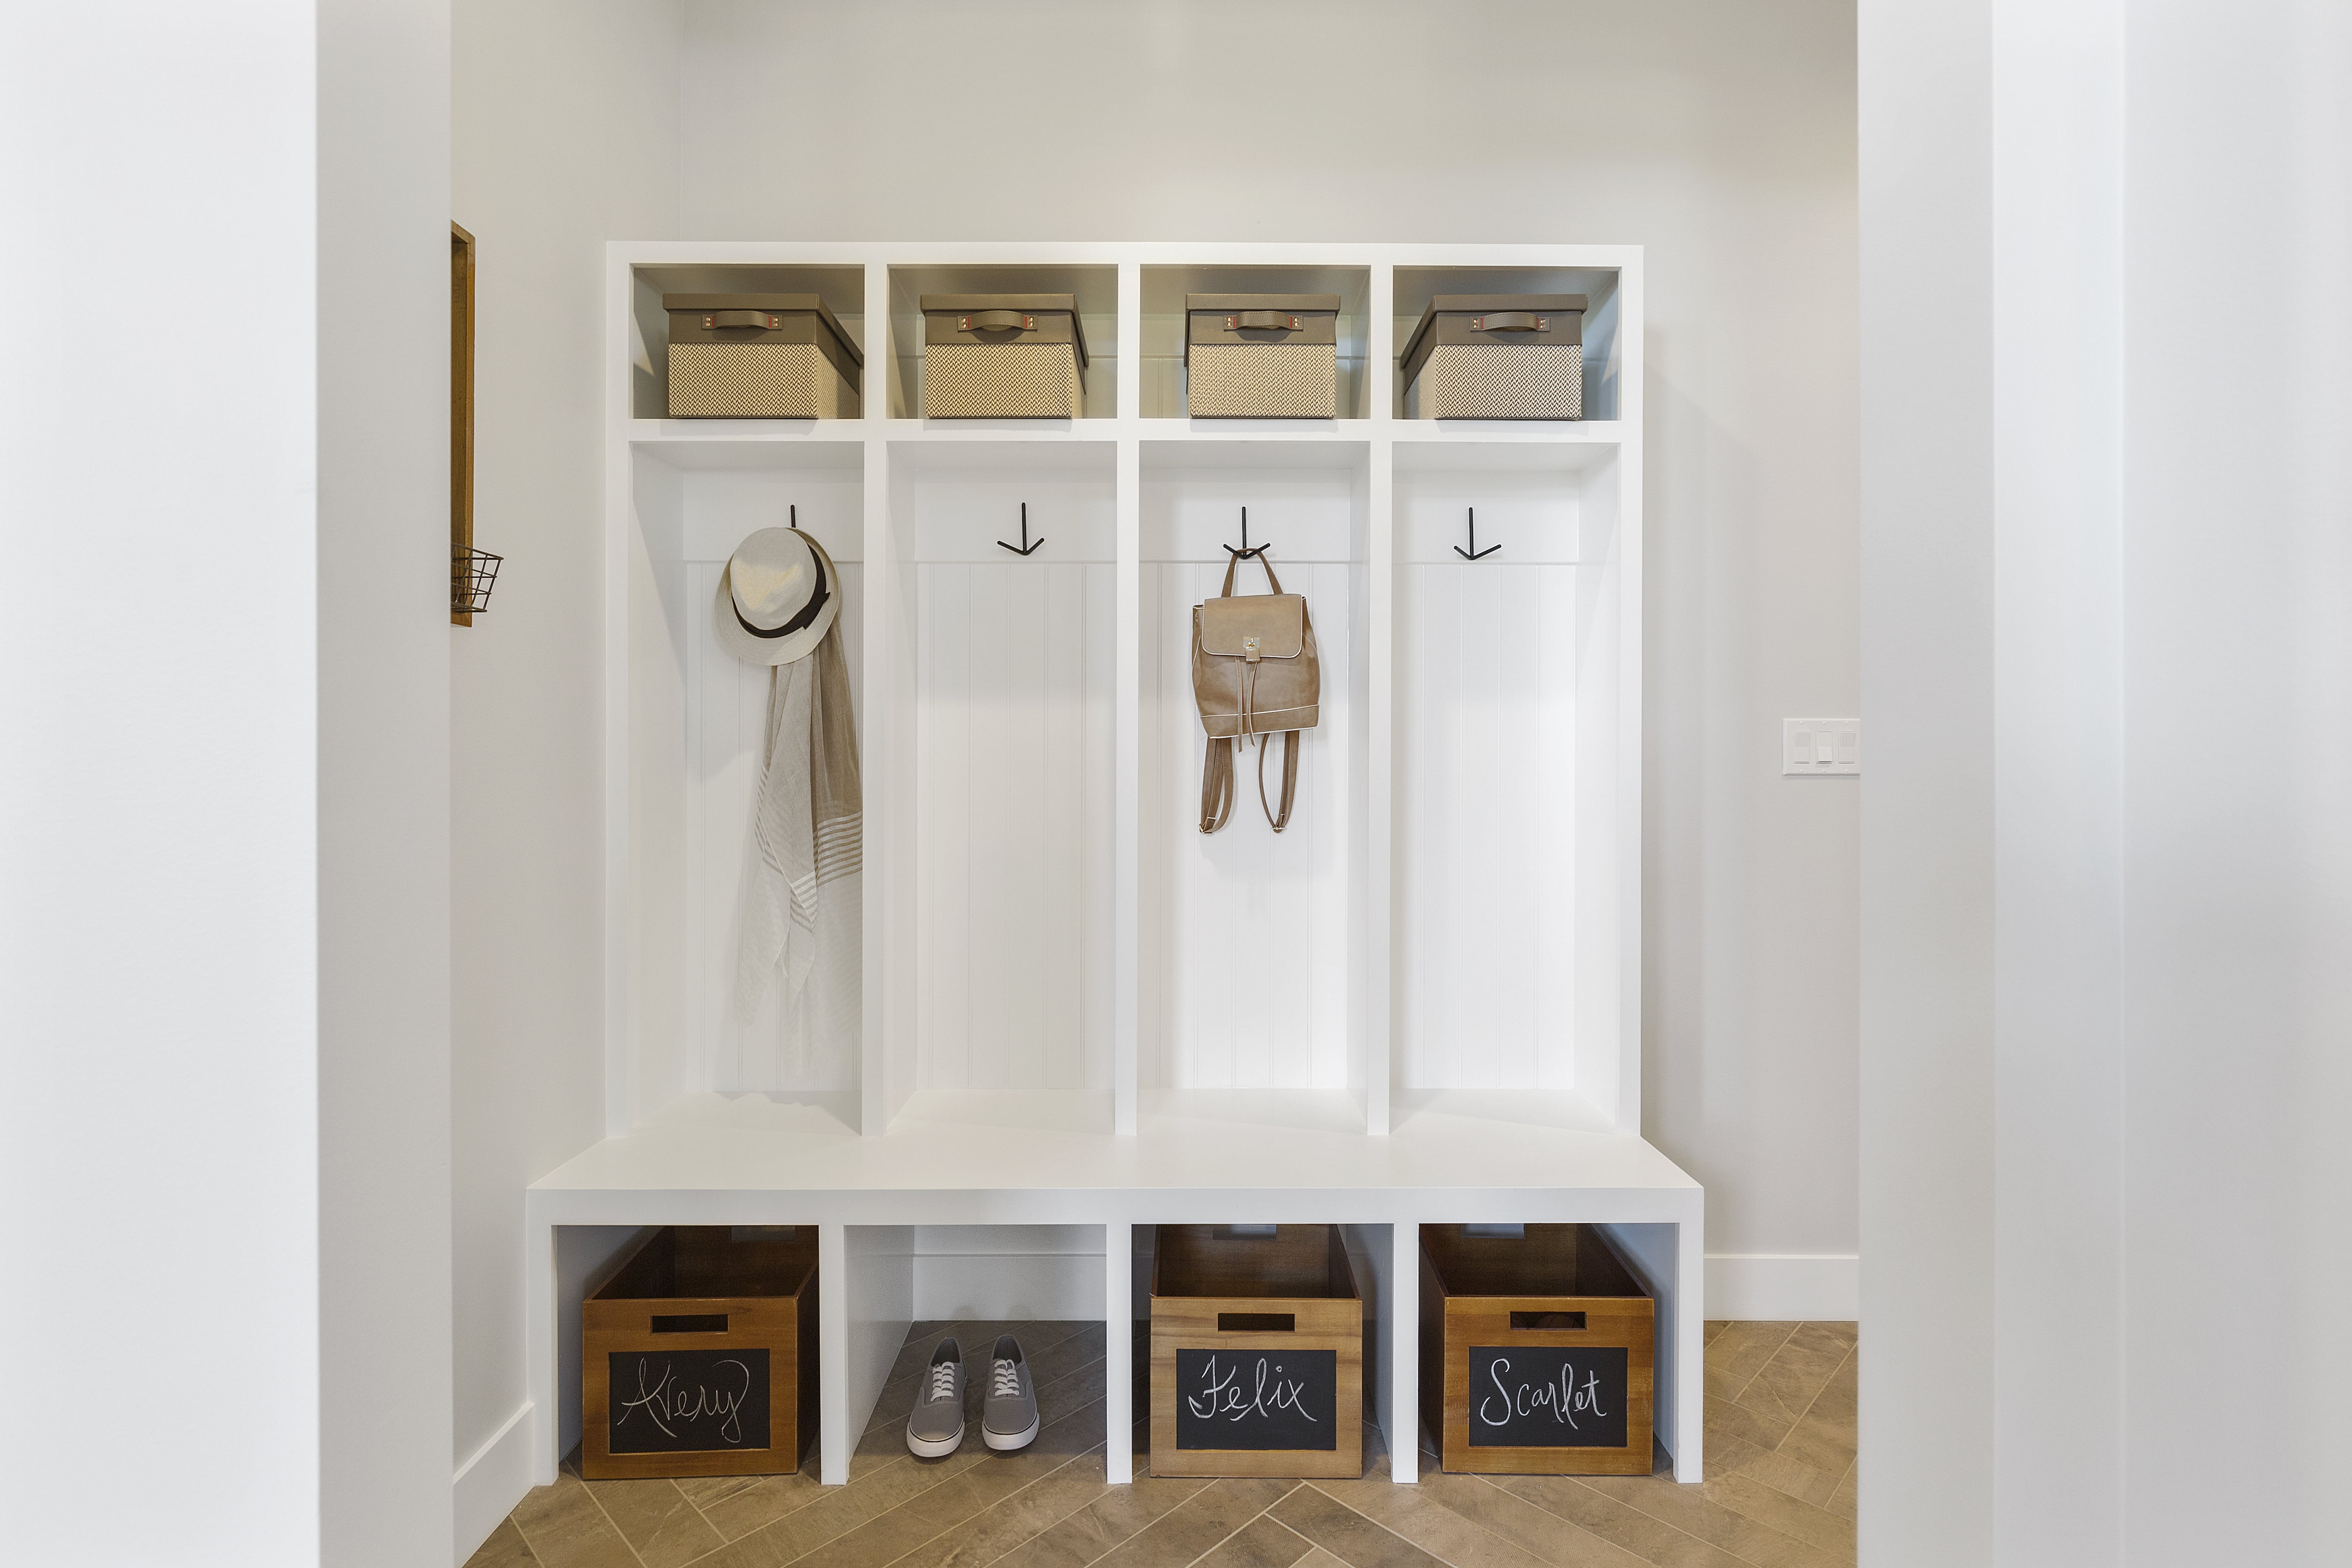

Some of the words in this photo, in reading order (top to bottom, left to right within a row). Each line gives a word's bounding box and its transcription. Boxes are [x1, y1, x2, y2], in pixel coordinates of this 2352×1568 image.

[617, 1357, 749, 1443] Avery
[1188, 1355, 1318, 1422] Felix
[1480, 1358, 1607, 1430] Scarlet
